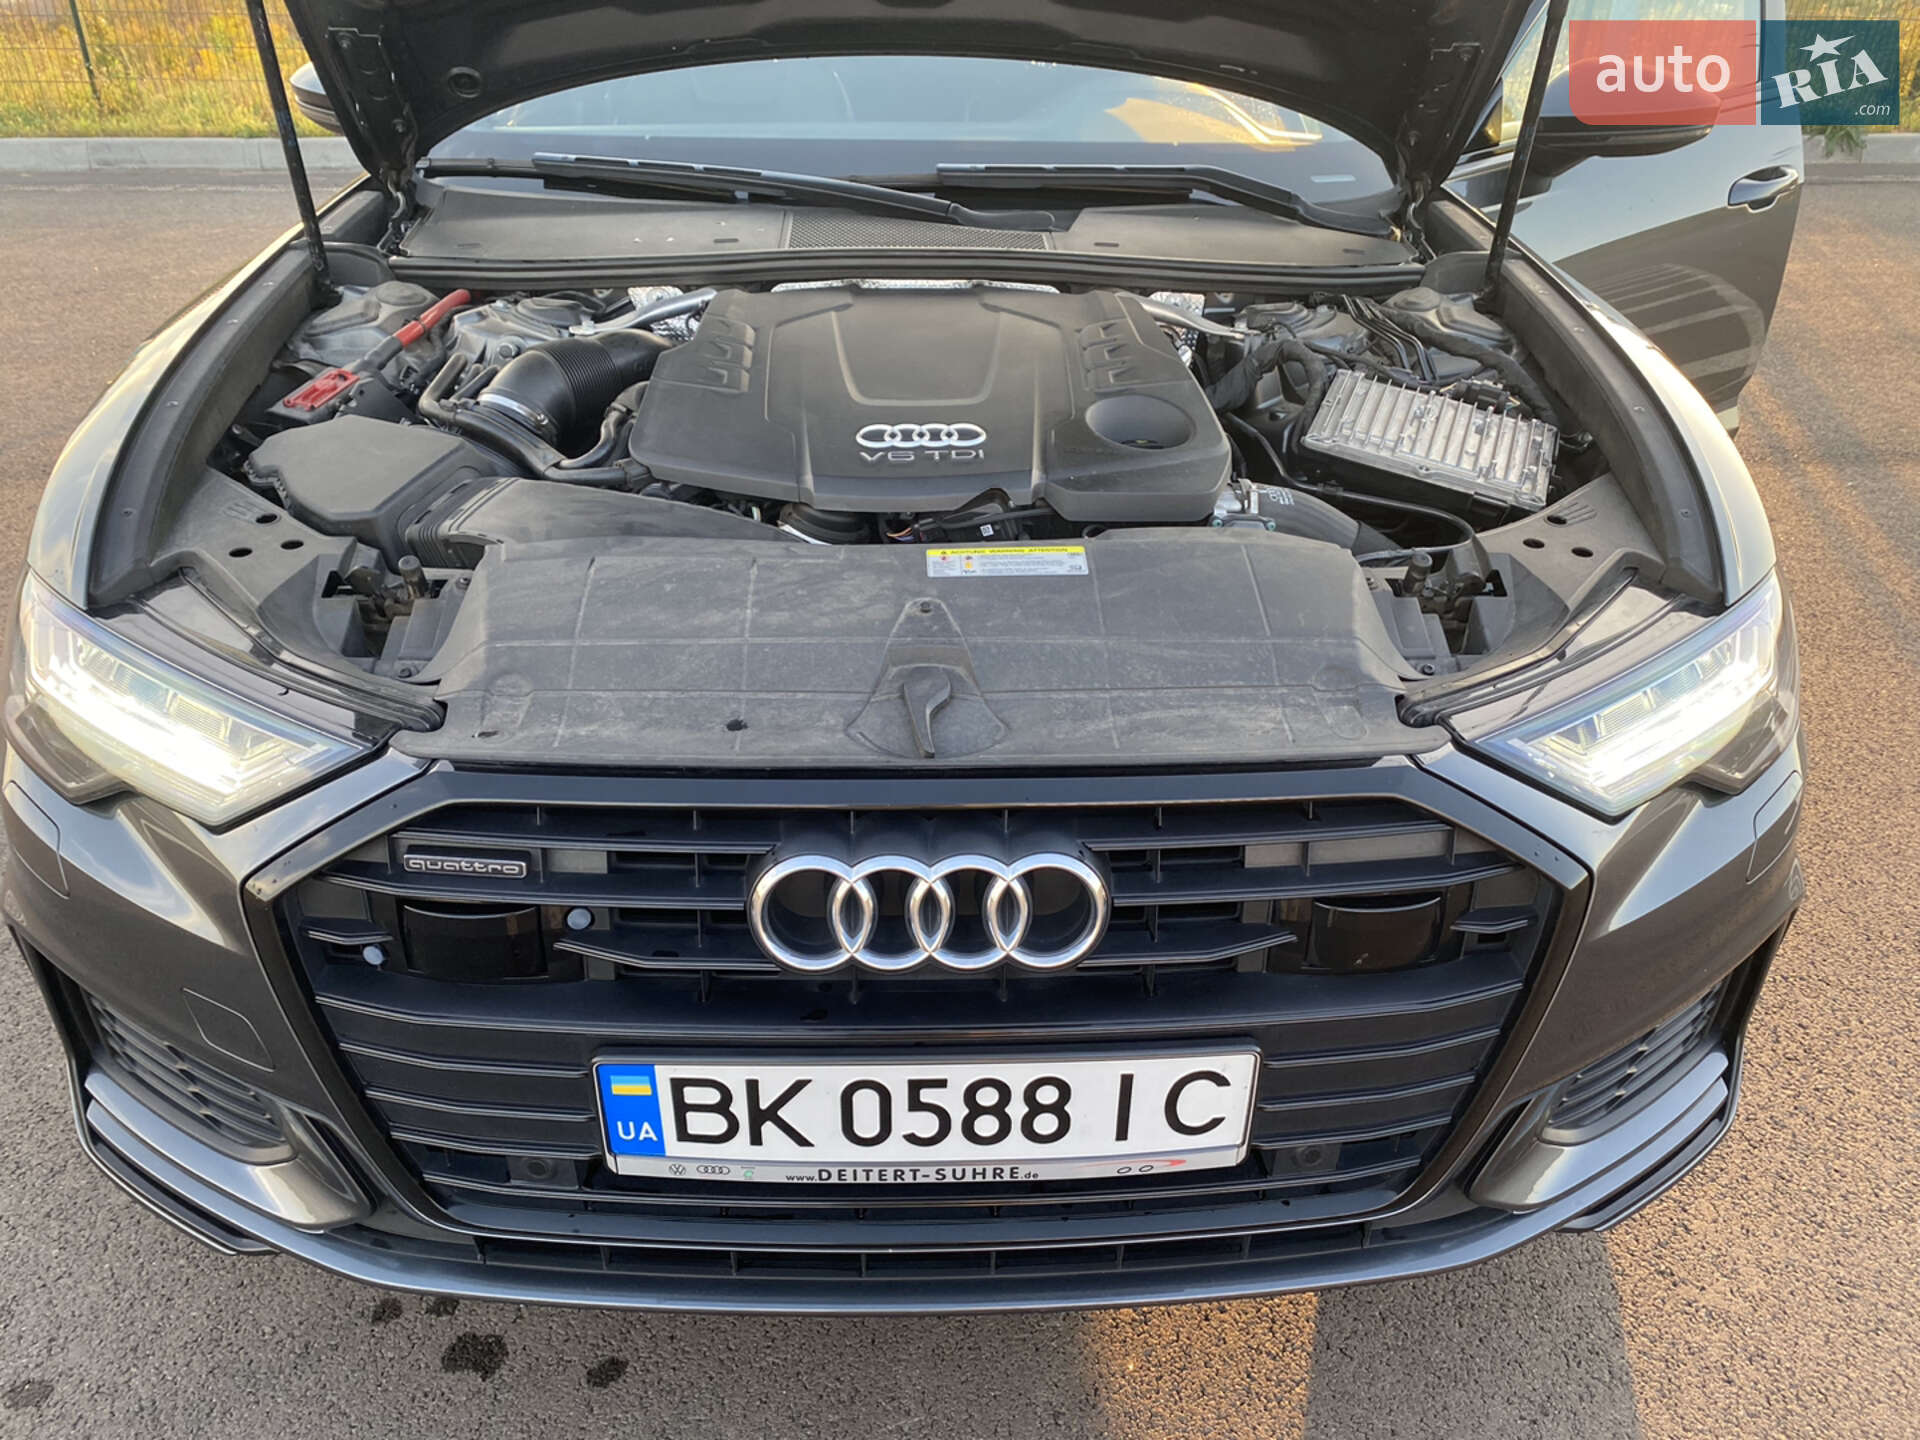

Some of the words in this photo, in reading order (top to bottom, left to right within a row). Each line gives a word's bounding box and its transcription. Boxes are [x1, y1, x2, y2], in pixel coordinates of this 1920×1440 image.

[860, 450, 915, 461] V6
[925, 449, 985, 461] TDI
[409, 859, 520, 874] quattro
[669, 1077, 815, 1147] BK
[840, 1076, 1072, 1147] 0588
[616, 1121, 658, 1141] UA
[785, 1167, 1039, 1183] www.DEITERT-SUHRE.de
